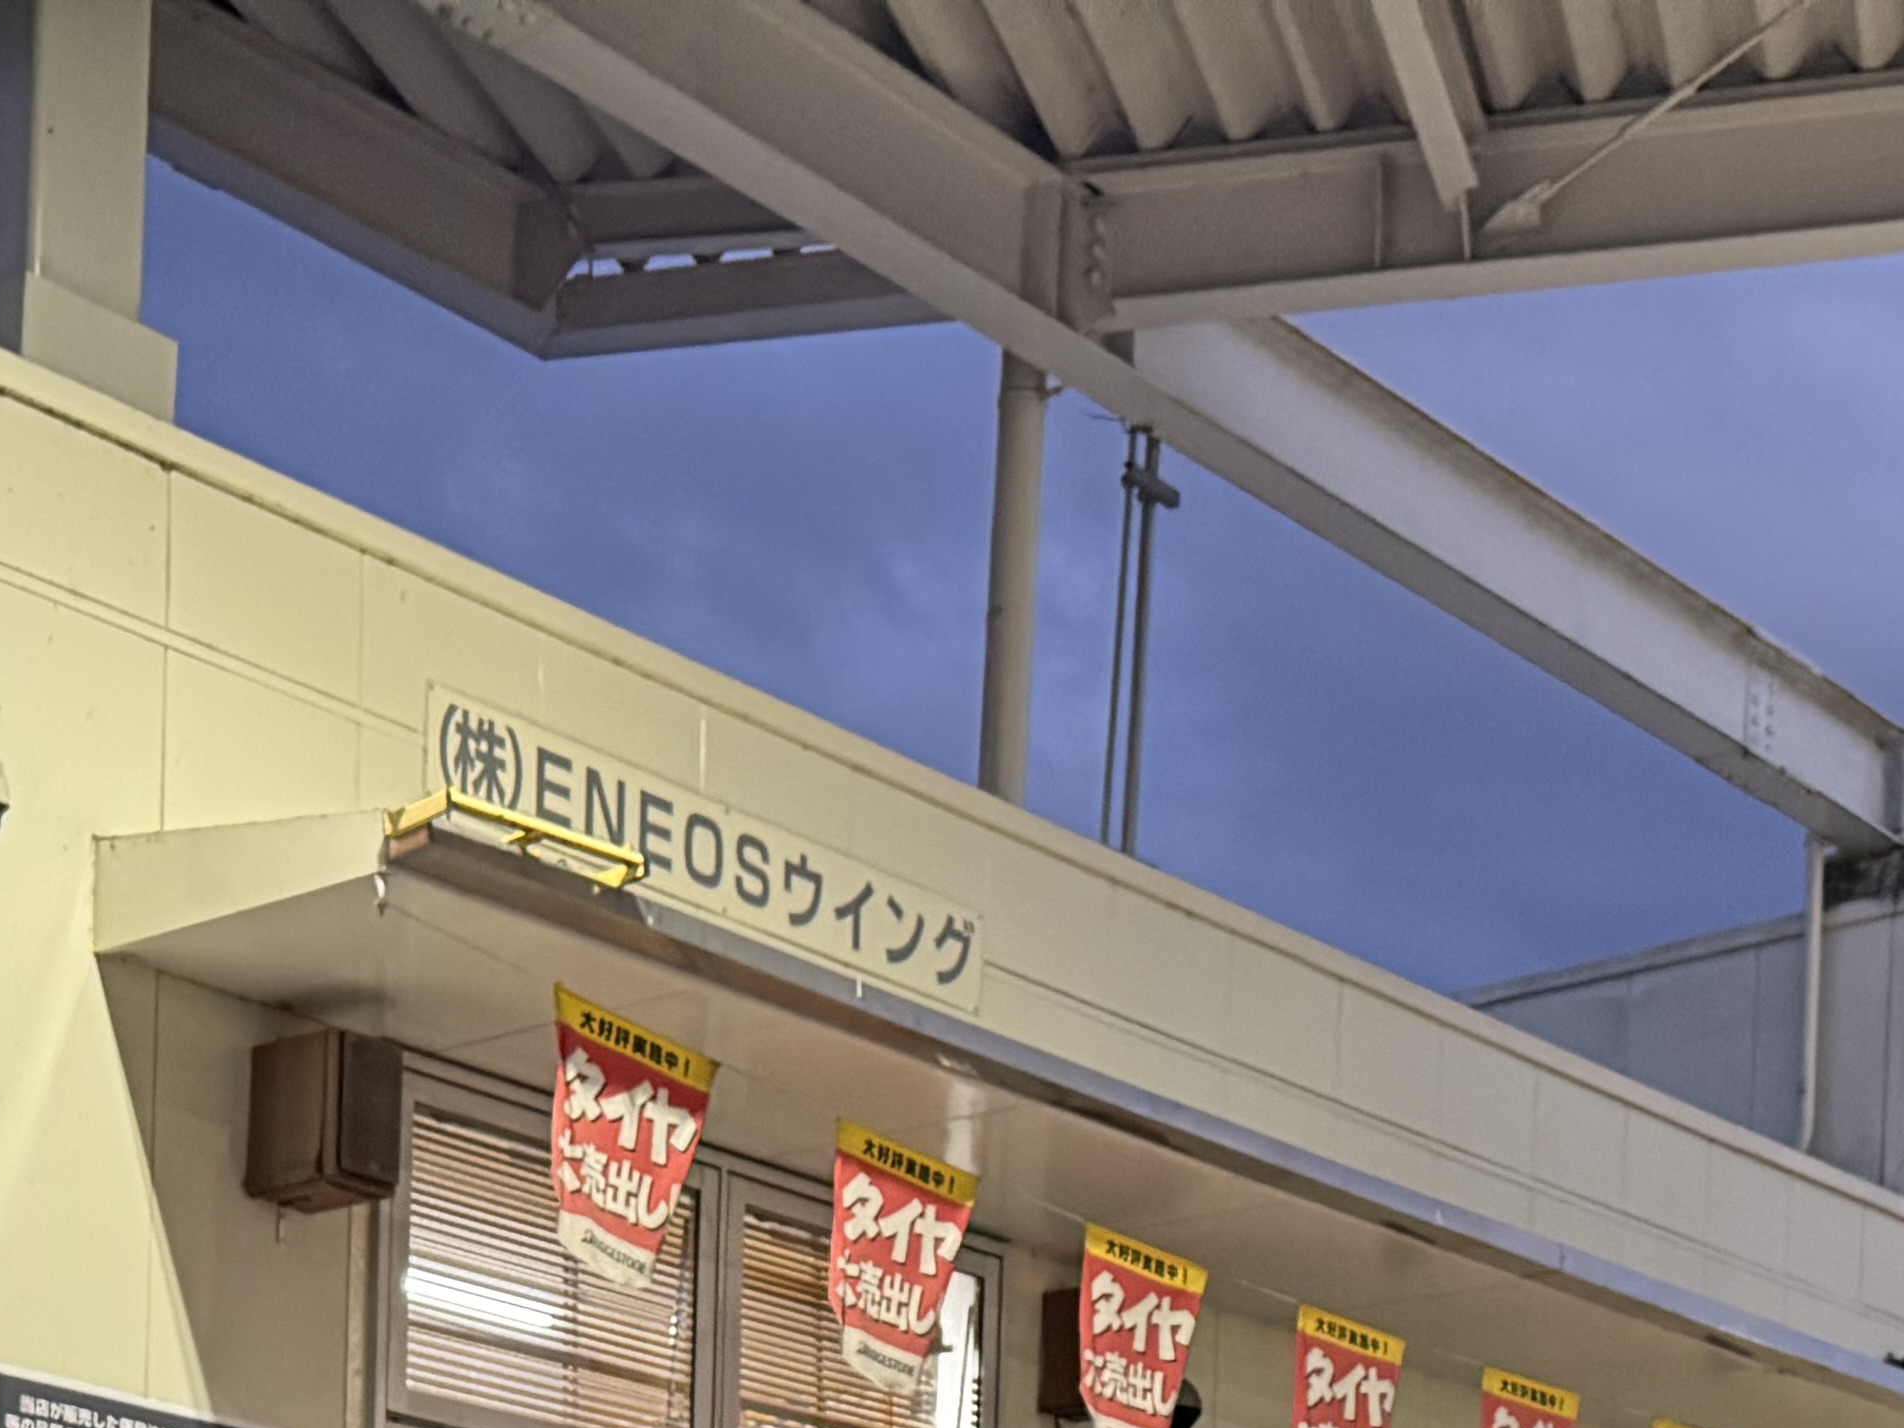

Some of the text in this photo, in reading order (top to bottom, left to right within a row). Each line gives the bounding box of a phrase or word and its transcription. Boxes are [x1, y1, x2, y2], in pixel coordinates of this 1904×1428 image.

[563, 1047, 698, 1165] タイヤ
[842, 1172, 962, 1276] タイヤ
[1091, 1271, 1195, 1362] タイヤ
[1304, 1347, 1395, 1428] タイヤ
